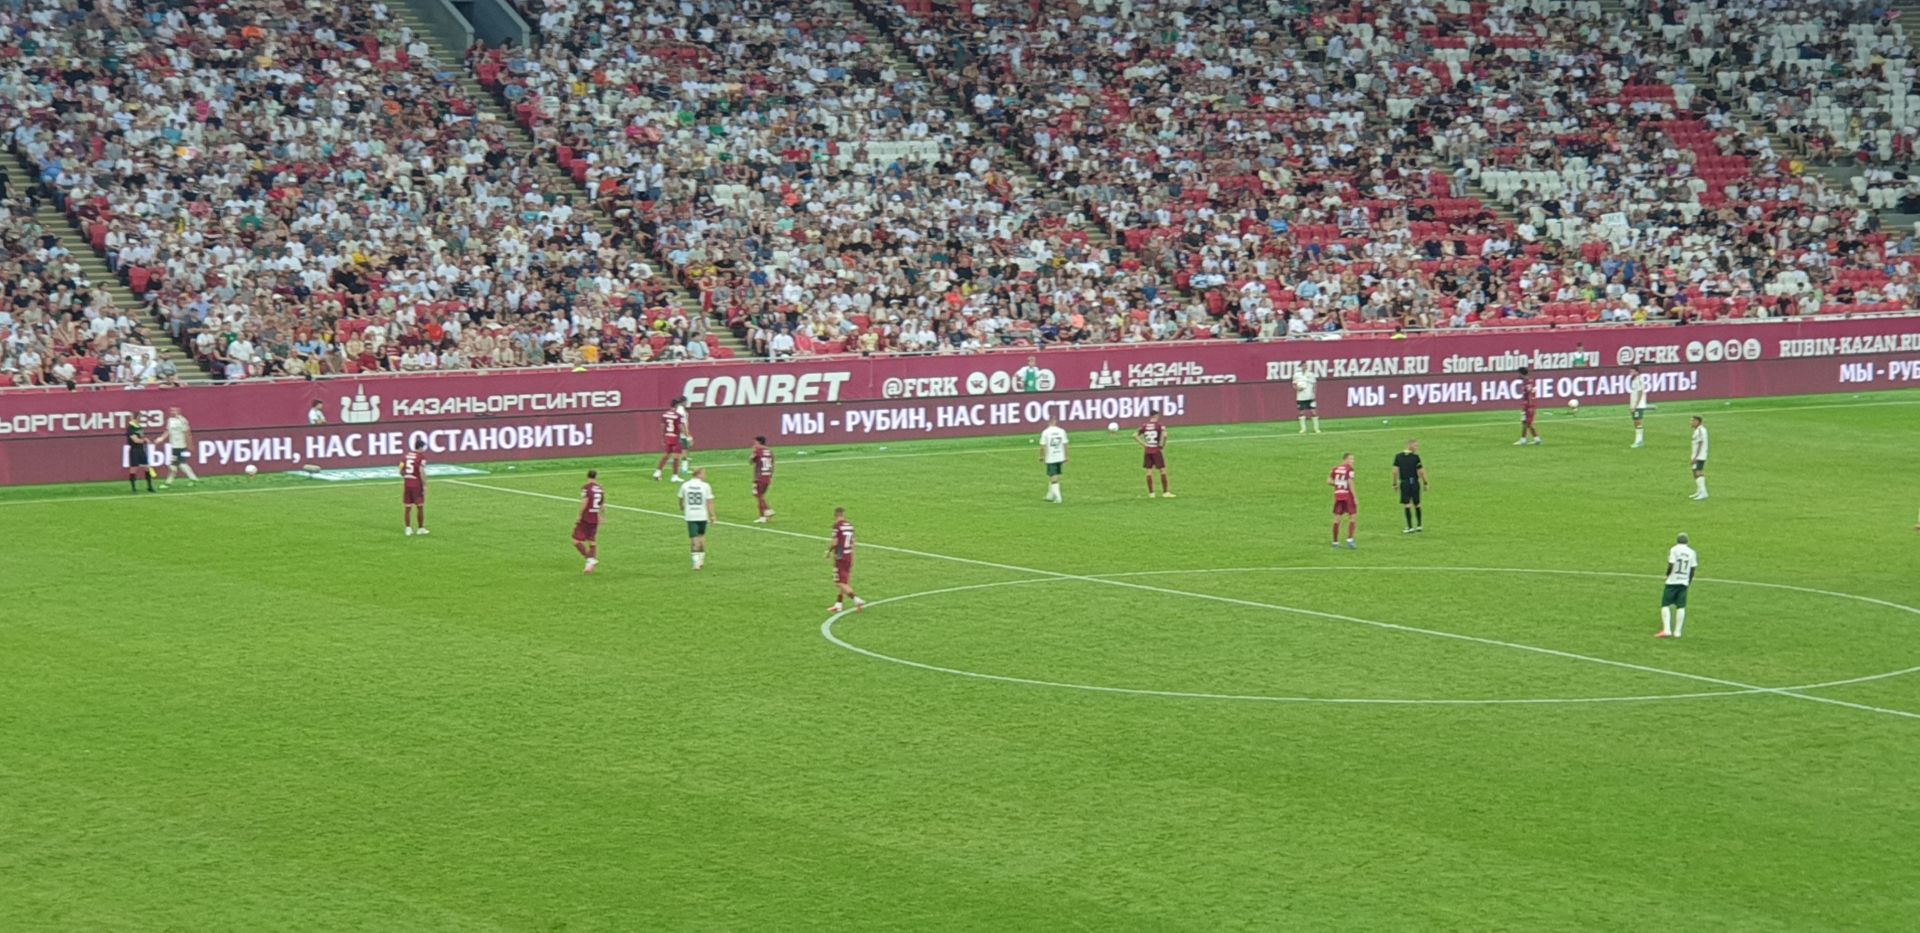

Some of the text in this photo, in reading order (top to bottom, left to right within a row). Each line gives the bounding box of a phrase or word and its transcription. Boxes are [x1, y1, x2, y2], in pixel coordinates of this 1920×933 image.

[1443, 350, 1599, 373] store.rubin-kazaru
[1616, 345, 1680, 366] @FCRK
[1128, 362, 1204, 378] КАЗАНЬ
[1839, 362, 1873, 382] МЫ
[683, 372, 850, 408] FONBET
[882, 377, 958, 399] @FCRK
[1347, 386, 1385, 407] МЫ
[1403, 382, 1477, 405] РУБИН,
[1481, 379, 1524, 400] НАС
[393, 390, 621, 416] КАЗАНЬОРГСИНТЕЗ
[666, 419, 674, 432] 3
[781, 412, 824, 435] МЫ
[845, 407, 933, 433] РУБИН,
[937, 404, 985, 427] НАС
[990, 402, 1020, 424] НЕ
[1024, 394, 1184, 423] ОСТАНОВИТЬ!
[198, 437, 301, 464] РУБИН,
[306, 433, 362, 459] НАС
[368, 432, 403, 456] НЕ
[408, 423, 593, 453] ОСТАНОВИТЬ!
[405, 459, 414, 474] 5
